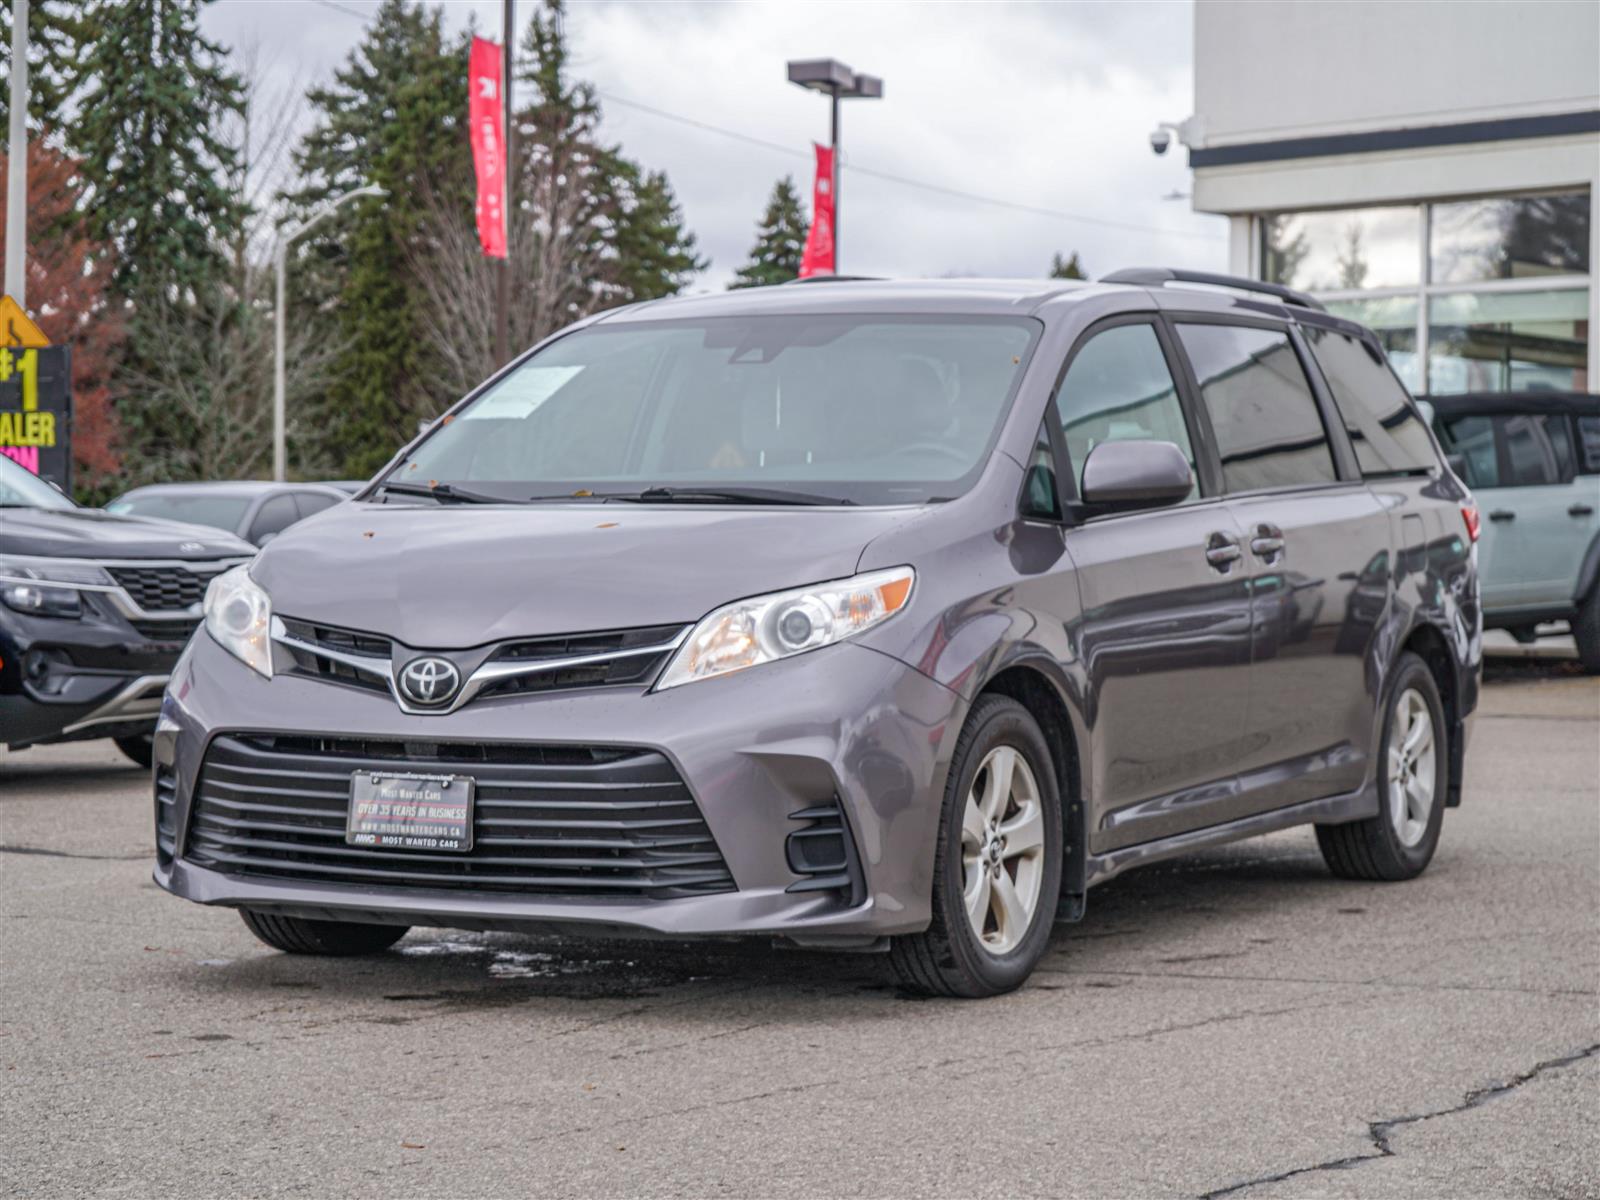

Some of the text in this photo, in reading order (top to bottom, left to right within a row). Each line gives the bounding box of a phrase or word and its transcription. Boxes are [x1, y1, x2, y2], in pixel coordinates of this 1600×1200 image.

[358, 803, 378, 815] OVER
[392, 805, 417, 817] YEARS
[418, 806, 427, 817] IN
[429, 807, 466, 819] BUSINESS
[382, 836, 403, 845] MOST
[405, 837, 437, 847] WANTED
[439, 839, 459, 849] CARS
